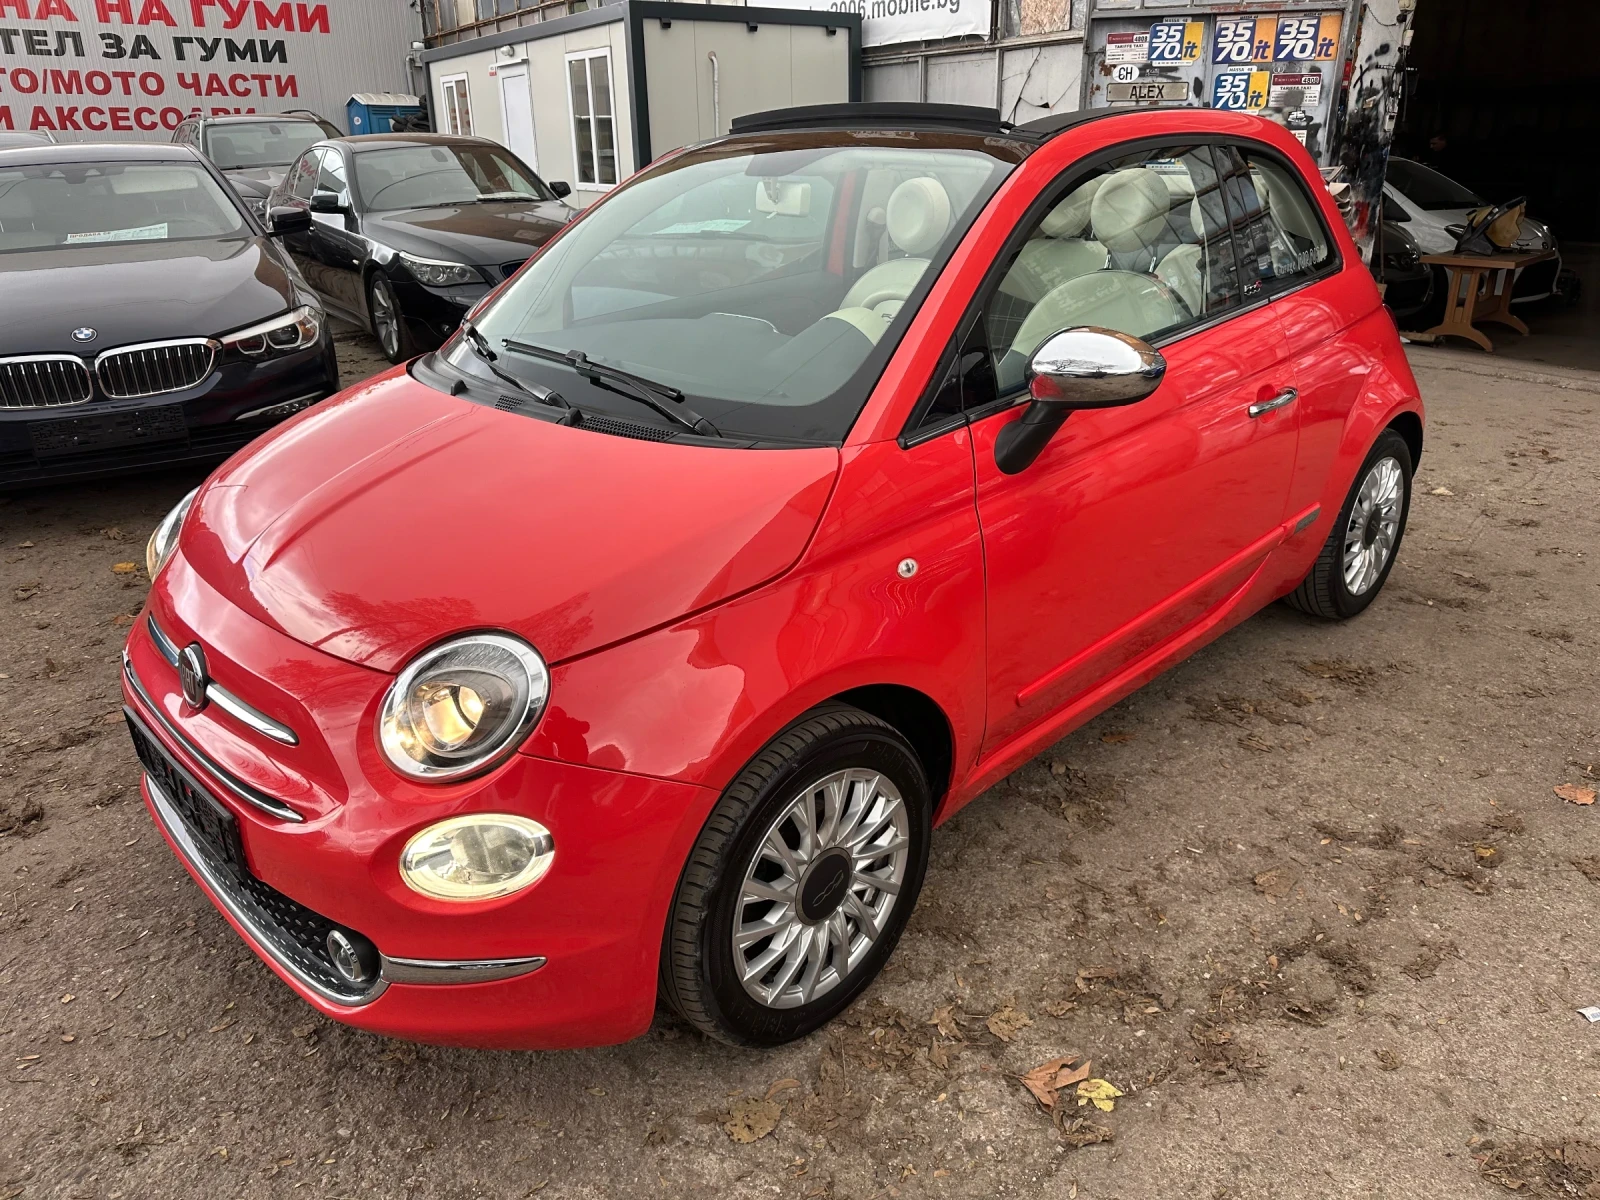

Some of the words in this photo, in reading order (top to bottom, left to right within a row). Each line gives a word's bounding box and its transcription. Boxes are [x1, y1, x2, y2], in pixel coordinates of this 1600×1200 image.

[95, 0, 178, 27] НА
[189, 0, 331, 34] ГУМИ
[1151, 25, 1183, 43] 35
[1217, 21, 1254, 42] 35
[1279, 18, 1318, 39] 35
[0, 28, 85, 57] ТЕЛ
[98, 32, 162, 60] ЗА
[172, 36, 288, 63] ГУМИ
[0, 67, 165, 96] О/МОТО
[176, 72, 299, 98] ЧАСТИ
[1129, 84, 1165, 99] ALEX
[1216, 74, 1248, 92] 35
